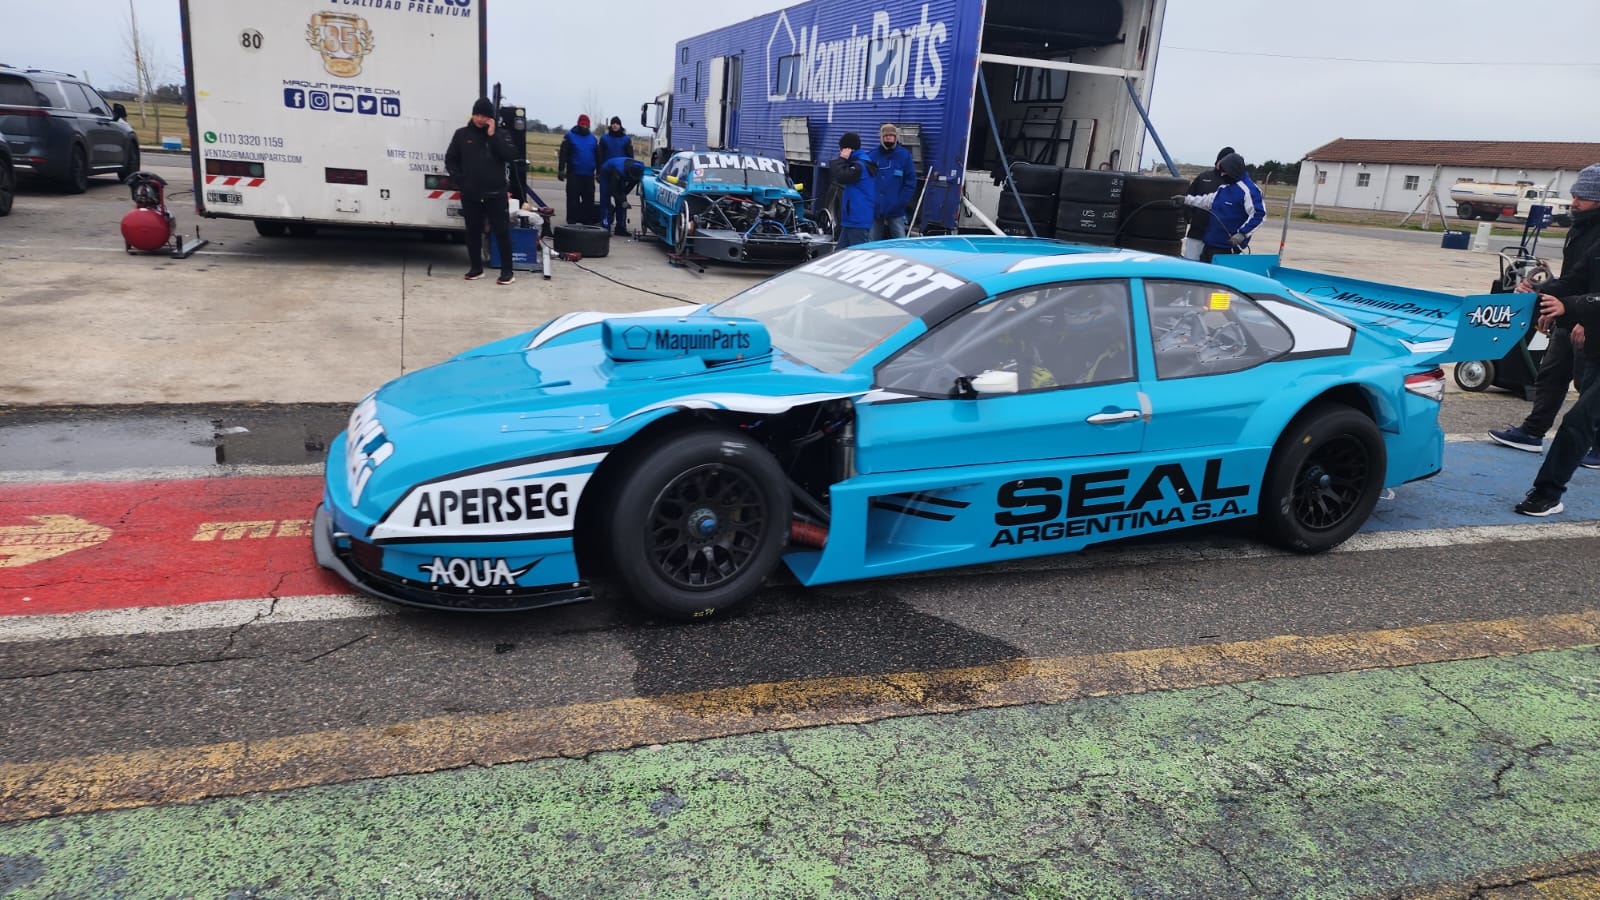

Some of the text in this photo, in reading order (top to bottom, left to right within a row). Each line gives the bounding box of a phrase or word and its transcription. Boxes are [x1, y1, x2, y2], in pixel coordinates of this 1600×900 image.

[408, 3, 471, 17] PREMIUM
[242, 32, 262, 49] 80
[324, 25, 360, 54] 85
[796, 3, 948, 123] MaquinParts
[219, 132, 284, 147] (11) 3320 1159
[204, 149, 302, 162] VENTAS@MAQUINPARTS.COM
[387, 149, 407, 158] MITRE
[692, 154, 785, 174] LIMART
[800, 250, 966, 305] LIMART
[1333, 292, 1449, 319] MaquinParts
[1468, 305, 1512, 324] AQUA
[655, 328, 750, 355] MaquinParts
[413, 482, 569, 527] APERSEG
[994, 458, 1250, 526] SEAL
[989, 499, 1247, 548] ARGENTINA S.A.
[429, 556, 516, 588] AQUA
